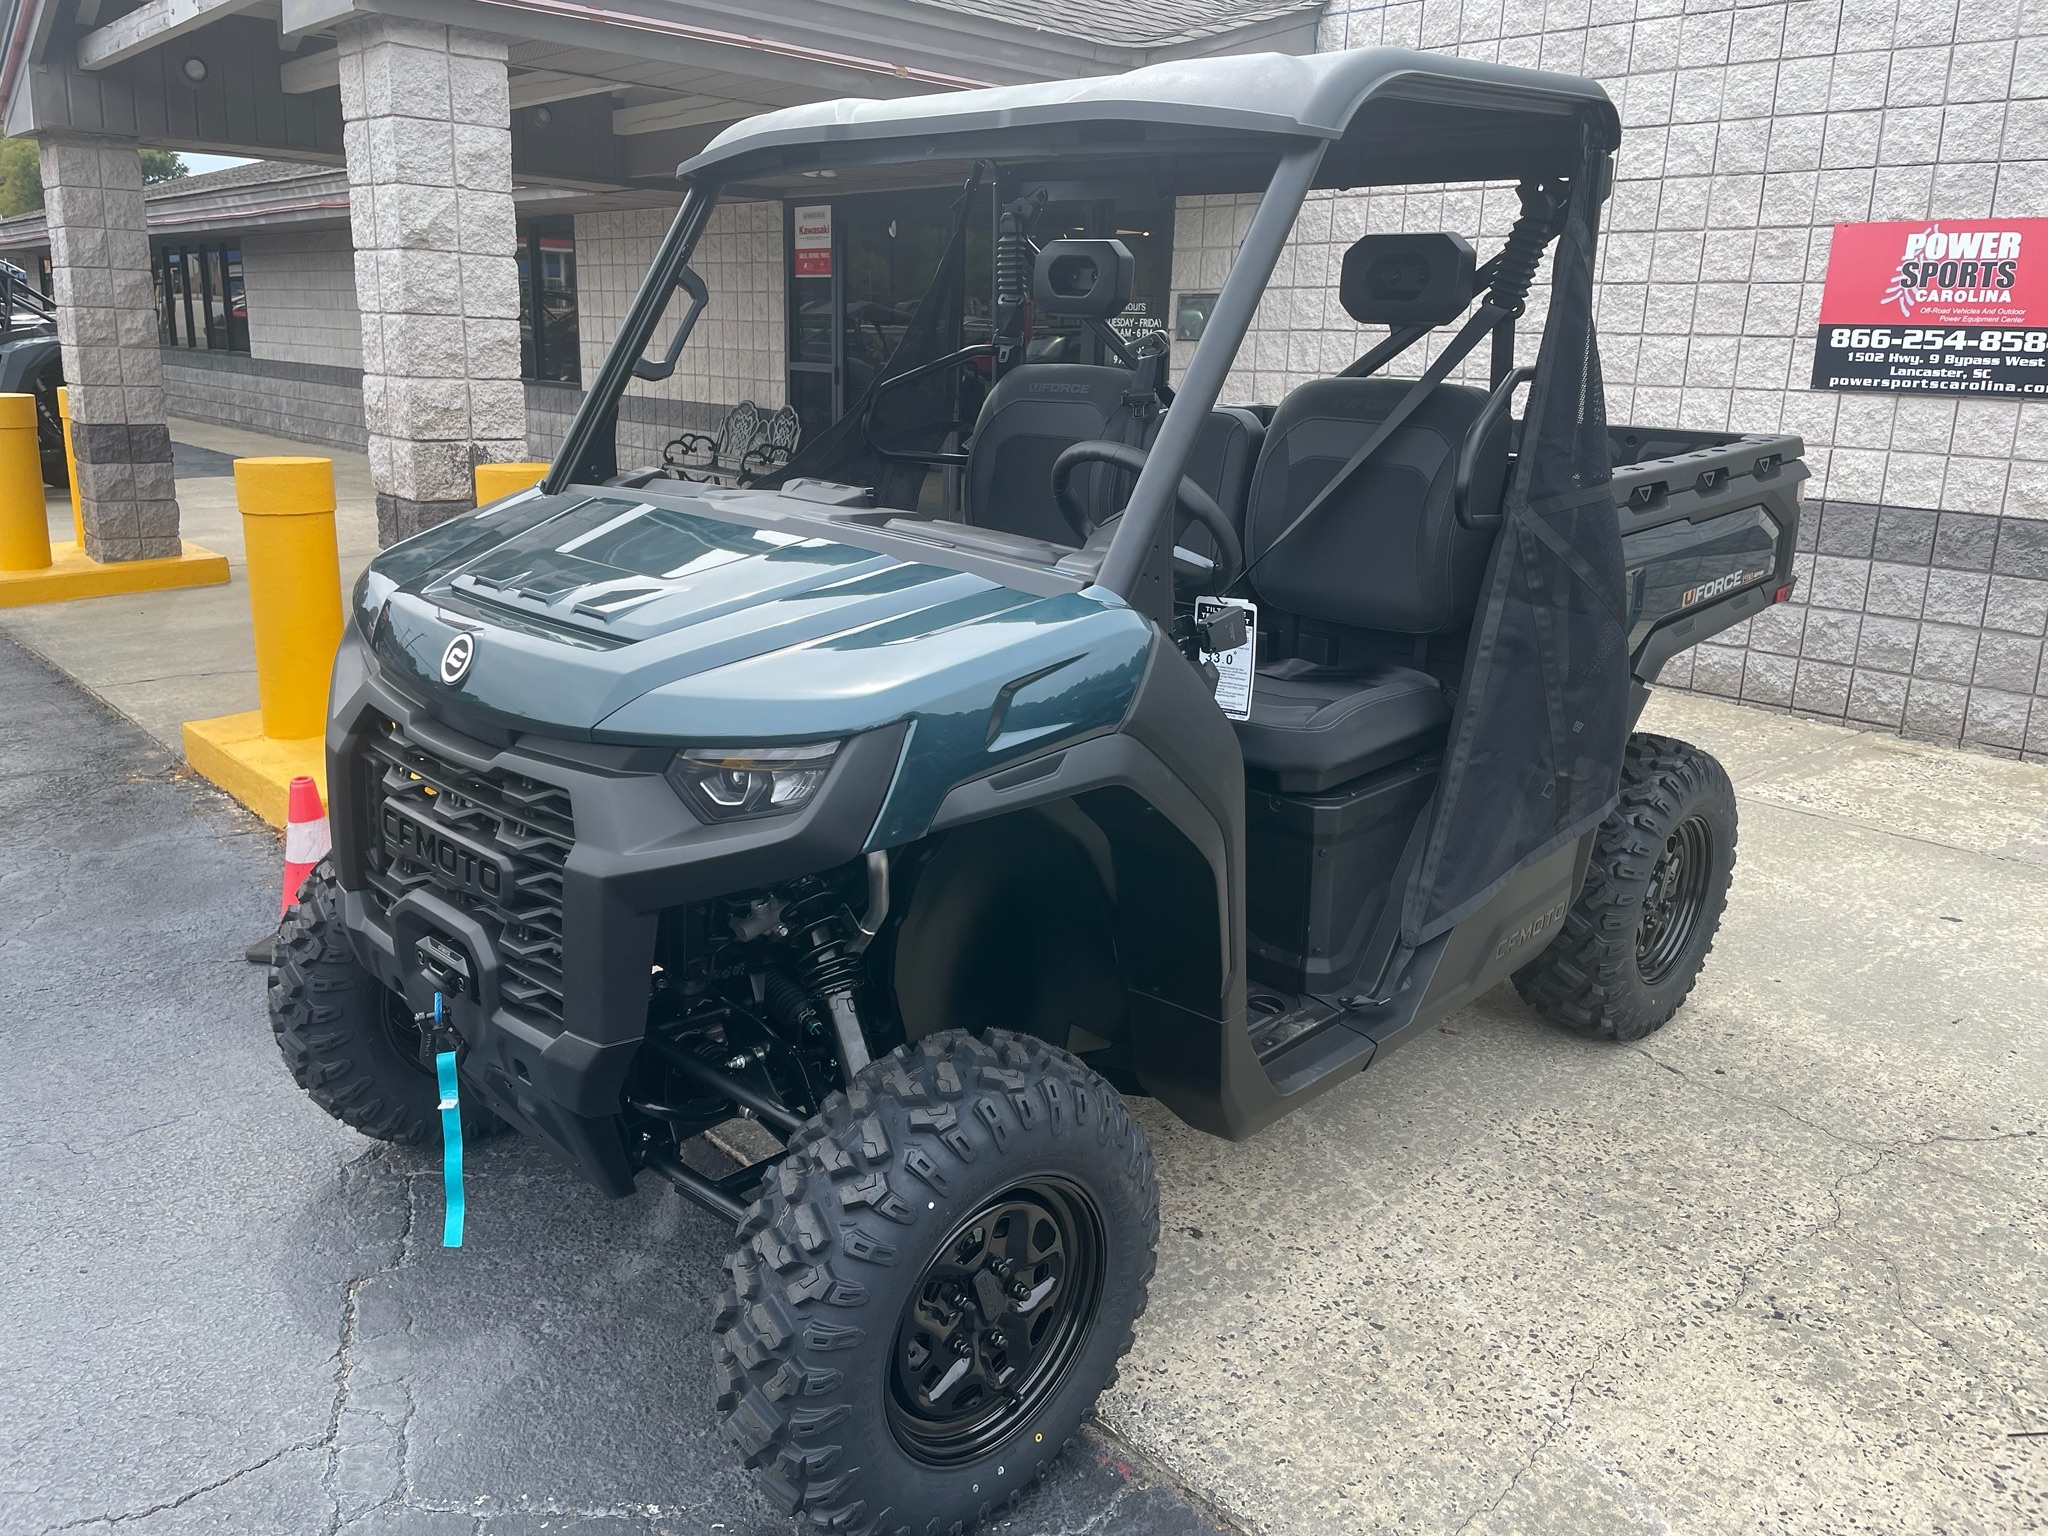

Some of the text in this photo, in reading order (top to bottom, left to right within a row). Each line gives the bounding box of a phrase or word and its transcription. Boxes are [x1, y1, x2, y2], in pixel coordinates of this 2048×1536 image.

[799, 225, 830, 235] Kawasaki
[1904, 231, 2022, 260] POWER
[1900, 260, 2017, 289] SPORTS
[1915, 290, 2012, 303] CAROLINA
[1126, 302, 1146, 311] ours
[1107, 318, 1134, 328] UESDAY
[1962, 316, 2000, 324] Equipment
[1136, 328, 1142, 338] 6
[1830, 328, 2048, 352] 866-254-858
[1848, 352, 2046, 367] 1502 Hwy. 9 Bypass West
[1890, 366, 1992, 379] Lancaster, SC
[1829, 377, 2048, 393] powersportscarolina.co
[383, 807, 502, 898] CFMOTO
[1496, 901, 1566, 960] CFMOTO
